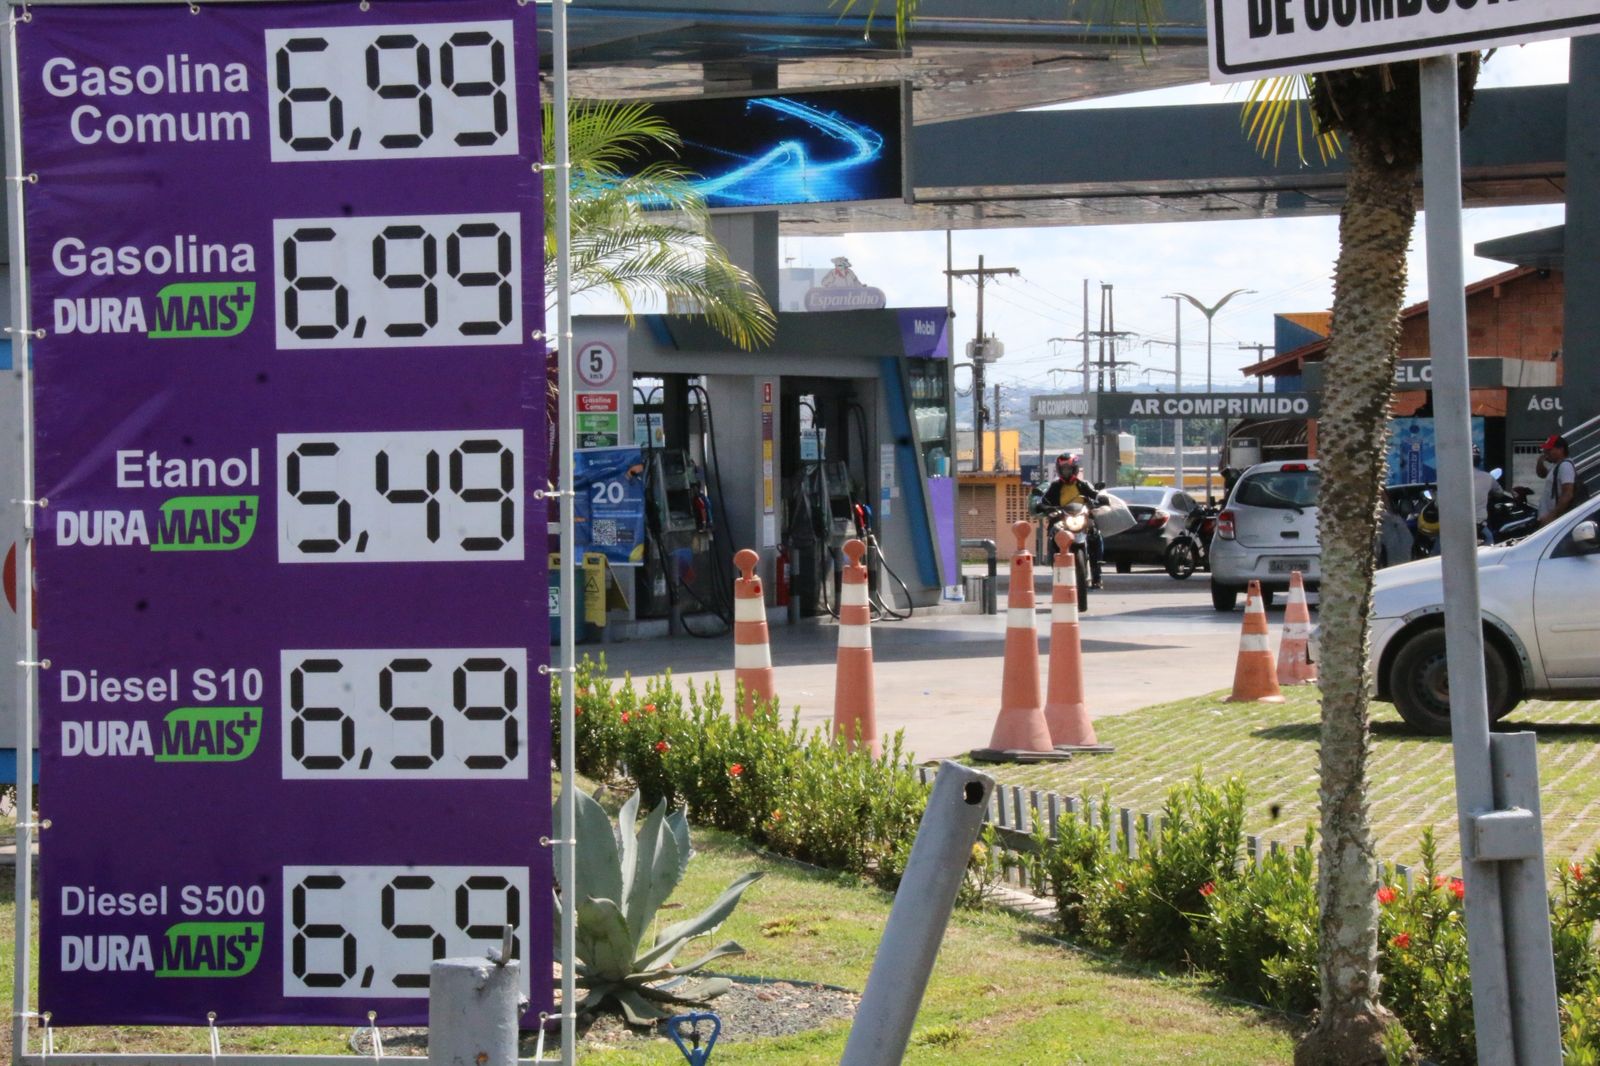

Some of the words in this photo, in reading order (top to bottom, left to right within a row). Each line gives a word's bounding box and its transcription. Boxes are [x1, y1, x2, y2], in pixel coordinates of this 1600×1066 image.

[42, 53, 249, 97] Gasolina
[275, 30, 509, 152] 6,99
[69, 104, 250, 145] Comum
[52, 234, 256, 277] Gasolina
[283, 222, 513, 340] 6,99
[809, 291, 880, 307] Espantalho
[53, 296, 148, 334] DURA
[914, 319, 935, 336] Mobil
[590, 349, 603, 373] 5
[1394, 364, 1433, 383] ELO
[582, 395, 612, 404] Gasolina
[1037, 399, 1046, 416] AR
[1047, 399, 1089, 417] COMPRIMIDO
[1129, 398, 1160, 415] AR
[1163, 397, 1309, 415] COMPRIMIDO
[1527, 394, 1564, 411] ÁGU
[116, 447, 260, 488] Etanol
[286, 439, 515, 554] 5,49
[592, 481, 625, 504] 20
[56, 509, 150, 547] DURA
[60, 668, 178, 702] Diesel
[192, 668, 263, 702] S10
[290, 657, 519, 770] 6,59
[61, 720, 154, 757] DURA
[61, 885, 168, 916] Diesel
[180, 885, 265, 916] S500
[292, 874, 520, 988] 6,59
[61, 935, 154, 972] DURA
